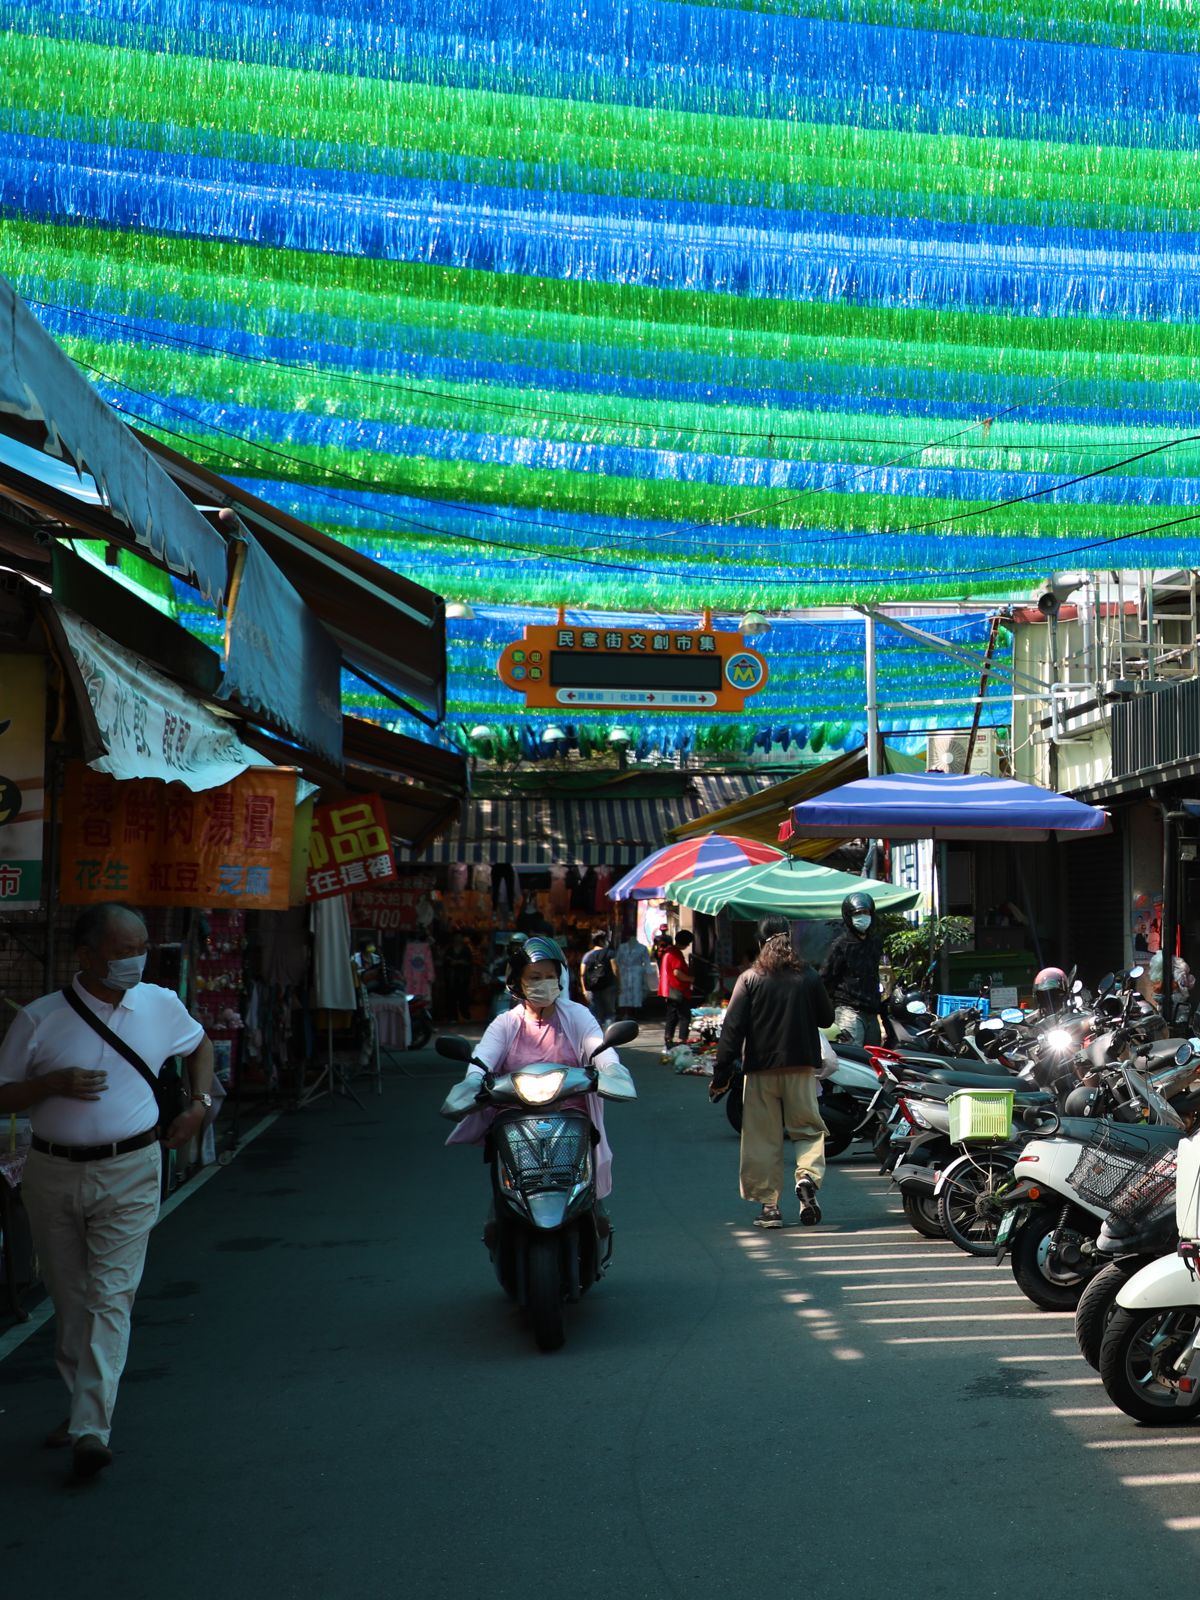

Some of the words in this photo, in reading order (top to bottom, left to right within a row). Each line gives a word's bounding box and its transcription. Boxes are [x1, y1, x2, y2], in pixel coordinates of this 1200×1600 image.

[557, 630, 716, 651] 民意街文創市集
[74, 860, 130, 892] 花生
[216, 863, 272, 897] 芝麻
[305, 853, 394, 896] 在這裡
